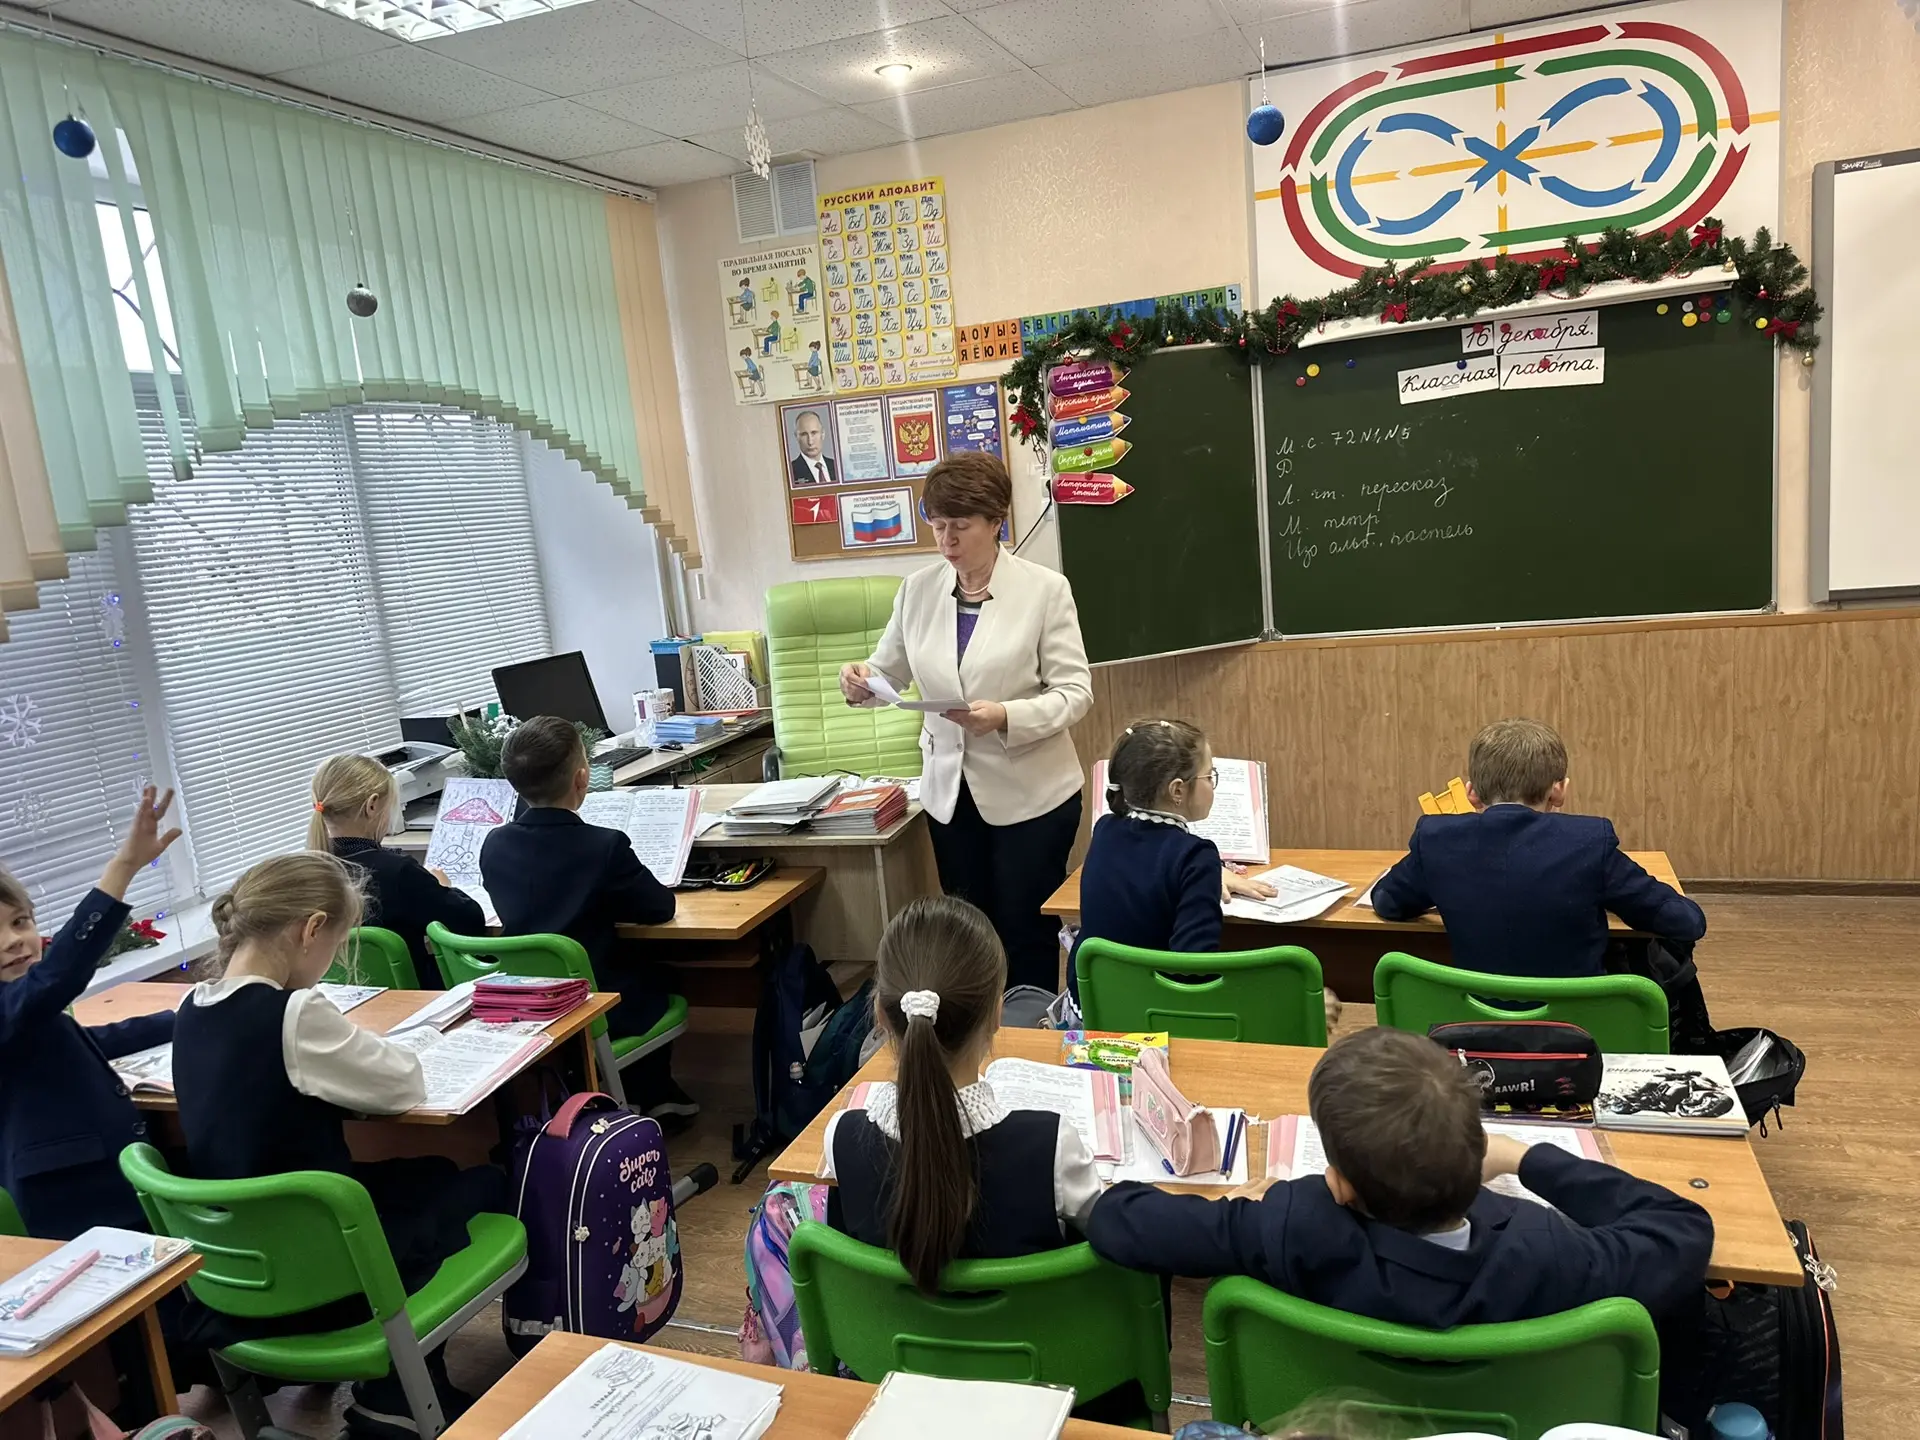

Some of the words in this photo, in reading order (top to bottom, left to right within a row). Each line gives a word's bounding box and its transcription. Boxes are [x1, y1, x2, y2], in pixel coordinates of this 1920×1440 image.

[1842, 161, 1865, 170] SMART
[824, 189, 874, 207] РУССКИЙ
[879, 181, 935, 197] АЛФАВИТ
[723, 253, 774, 267] ПРАВИЛЬНАЯ
[775, 247, 813, 259] ПОСАДКА
[768, 257, 806, 269] ЗАНЯТИЙ
[961, 331, 967, 342] А
[972, 329, 978, 340] О
[984, 326, 989, 338] У
[997, 324, 1005, 336] Ы
[1011, 323, 1017, 334] Э
[1037, 319, 1043, 330] В
[1466, 327, 1491, 348] 16
[961, 350, 967, 361] Я
[974, 345, 979, 359] Ё
[984, 346, 994, 357] Ю
[1000, 344, 1007, 355] И
[1013, 342, 1019, 353] Е
[1056, 366, 1106, 383] Английский
[1401, 366, 1498, 393] Классная
[1055, 420, 1112, 437] Математика
[1331, 429, 1356, 445] 72
[1361, 477, 1454, 511] пересказ
[1391, 524, 1473, 545] пастель
[1495, 1079, 1535, 1093] RAWR!
[619, 1149, 660, 1182] Super
[630, 1167, 656, 1193] cats
